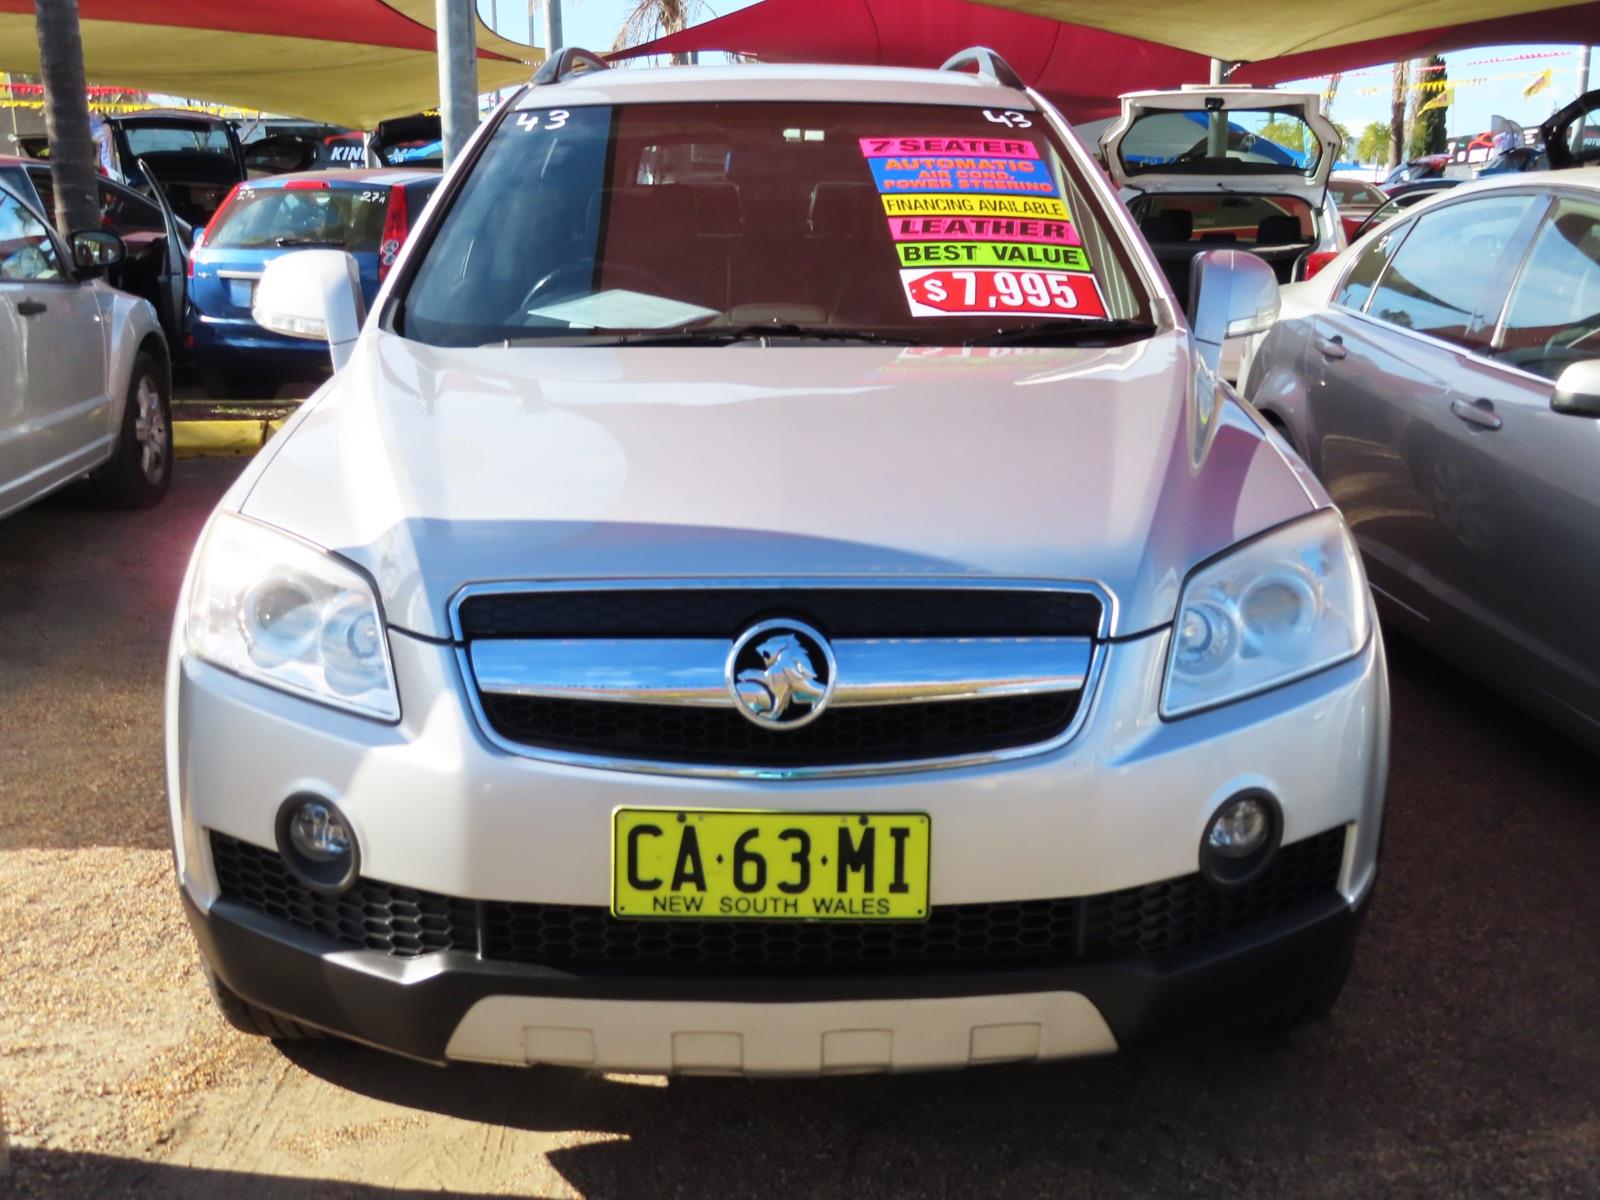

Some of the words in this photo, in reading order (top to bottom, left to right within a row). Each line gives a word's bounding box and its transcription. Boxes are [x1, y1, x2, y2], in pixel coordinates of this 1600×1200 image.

[516, 109, 570, 132] 43
[982, 109, 1033, 128] 43
[330, 146, 366, 161] KIN
[870, 140, 890, 153] 7
[900, 140, 1026, 155] SEATER
[885, 159, 1035, 173] AUTOMATIC
[918, 170, 952, 180] AIR
[956, 171, 1015, 181] COND.
[883, 179, 953, 189] POWER
[958, 180, 1054, 193] STEERING
[886, 199, 975, 212] FINANCING
[979, 200, 1064, 216] AVAILABLE
[900, 219, 1066, 239] LEATHER
[903, 245, 978, 262] BEST
[992, 246, 1081, 265] VALUE
[652, 896, 705, 913] NEW
[719, 897, 799, 914] SOUTH
[813, 898, 890, 915] WALES
